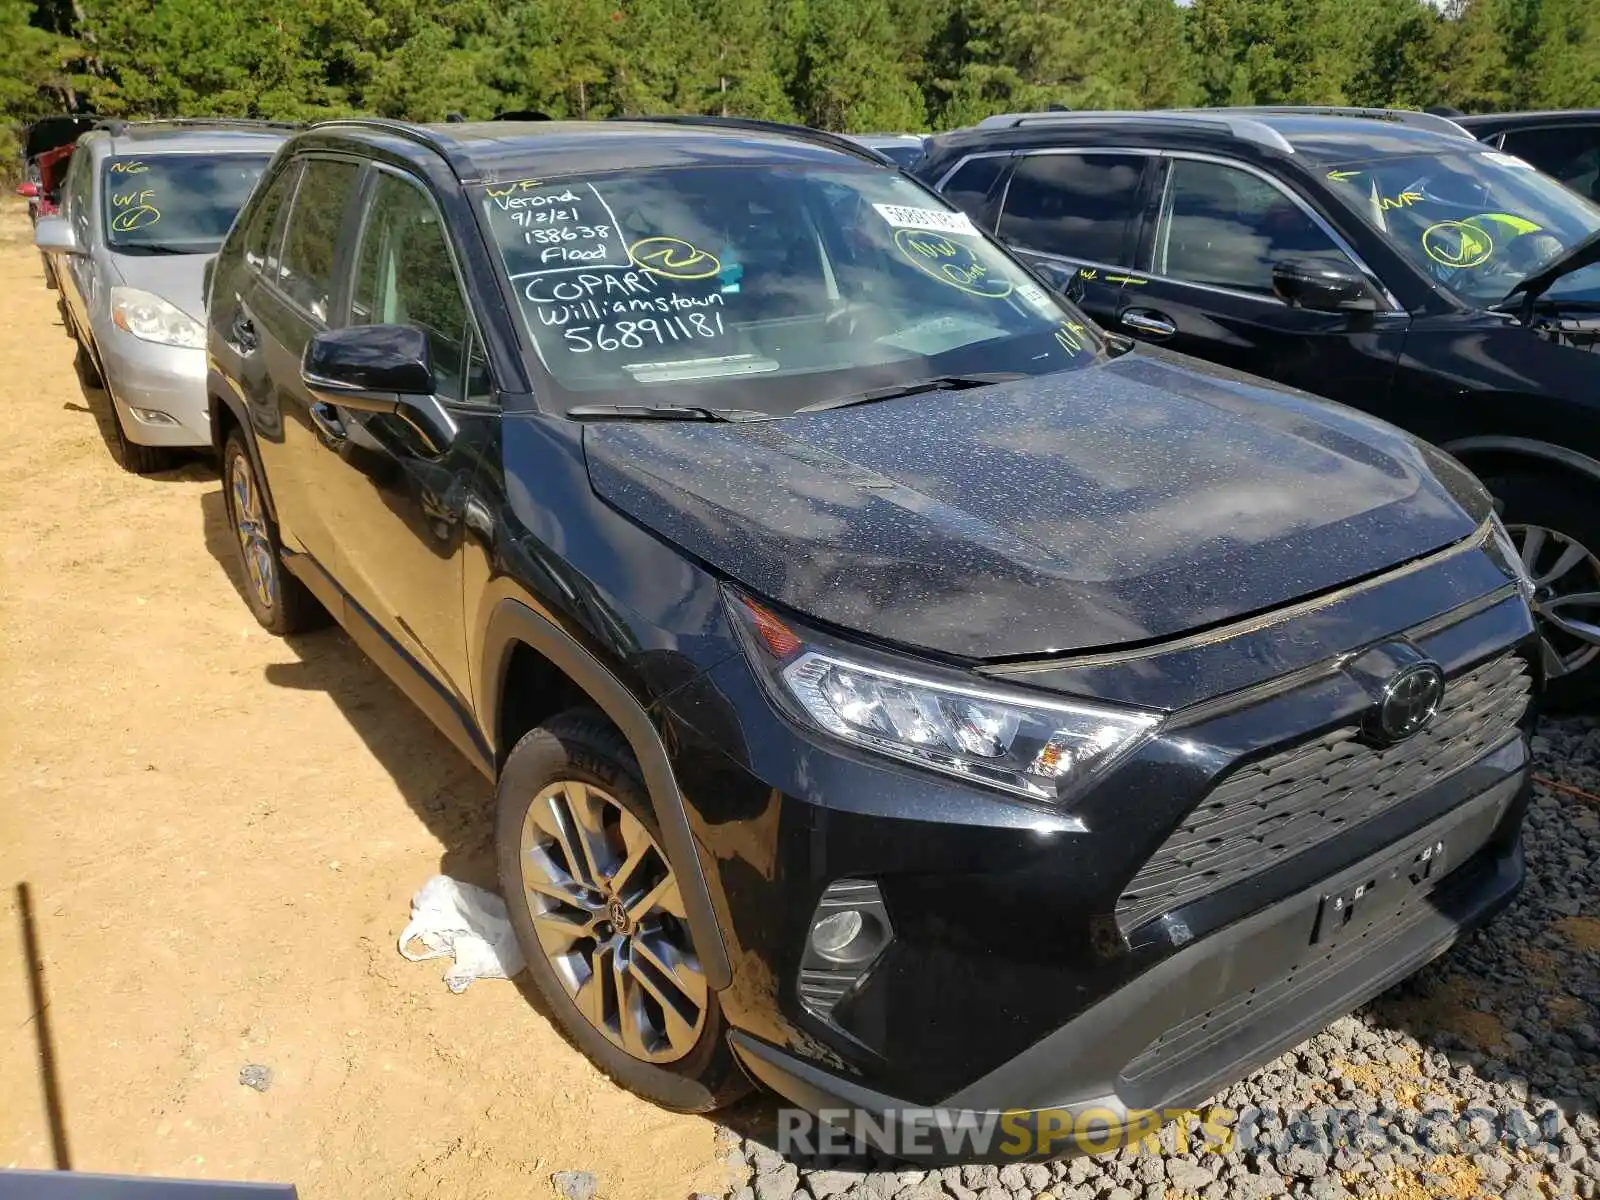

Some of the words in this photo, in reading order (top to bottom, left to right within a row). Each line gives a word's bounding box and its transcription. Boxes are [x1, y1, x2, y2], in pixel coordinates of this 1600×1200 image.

[510, 207, 578, 227] 9/2/21
[525, 224, 611, 245] 138638
[540, 243, 607, 264] Flood
[525, 269, 659, 302] COPART
[537, 292, 725, 326] Williamstown
[563, 311, 725, 353] 56891181
